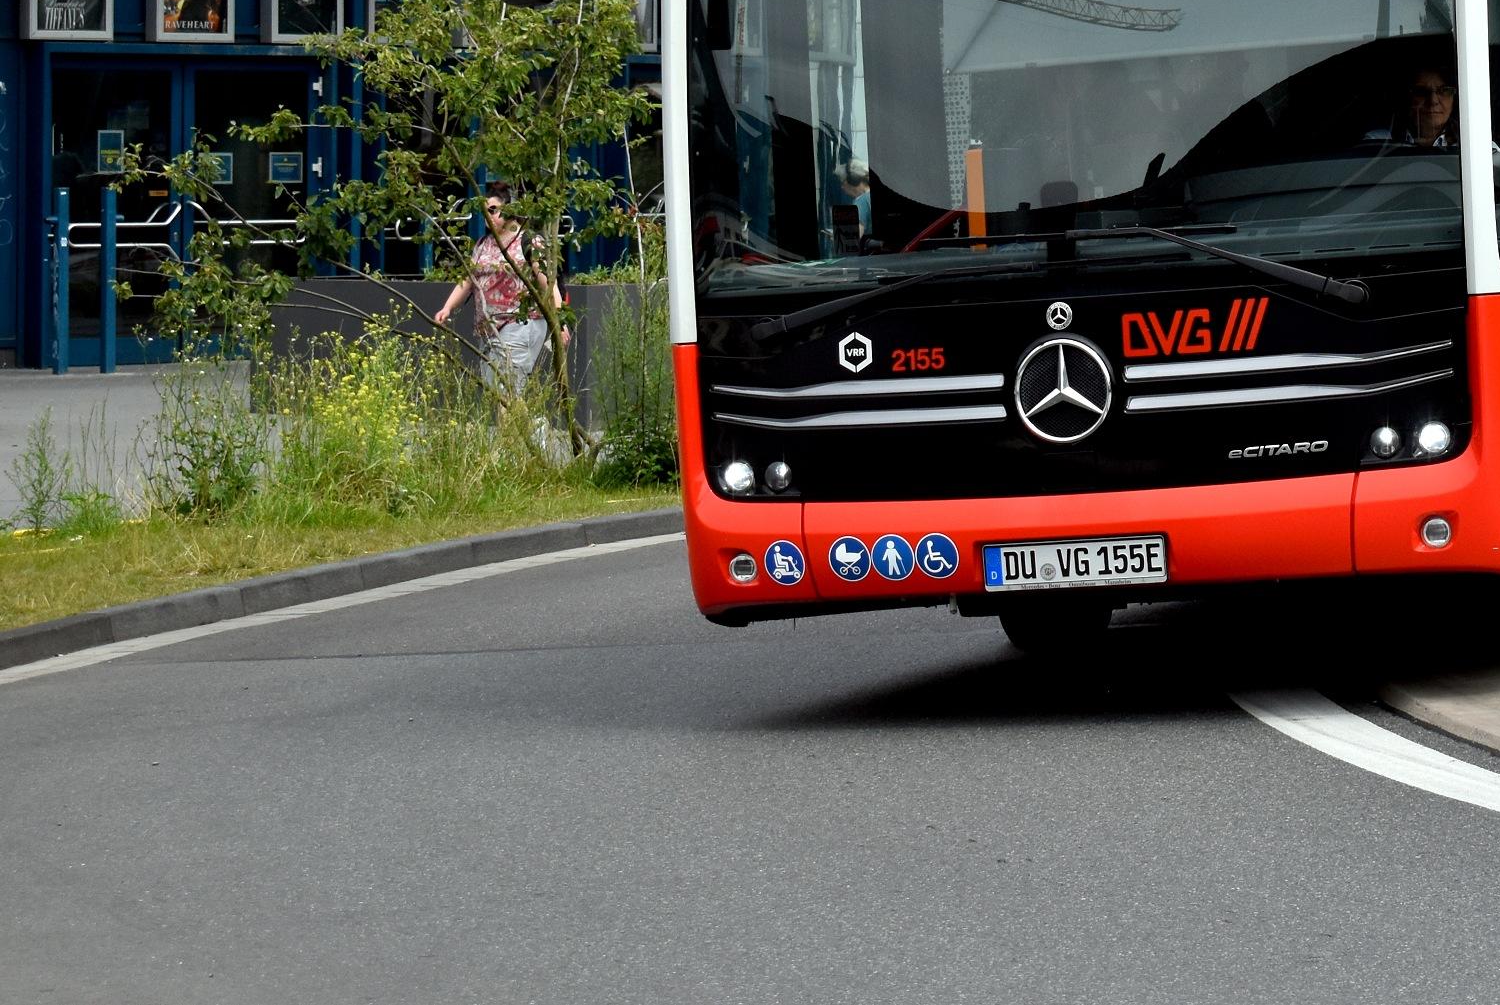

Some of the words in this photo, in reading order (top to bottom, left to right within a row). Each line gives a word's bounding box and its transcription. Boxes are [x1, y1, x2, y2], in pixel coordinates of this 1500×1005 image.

[165, 19, 216, 30] RAVEHEART
[1122, 308, 1212, 357] DVG
[846, 347, 865, 358] VRR
[891, 348, 945, 372] 2155
[1228, 440, 1329, 459] eCITARO
[1003, 550, 1037, 581] DU
[1056, 547, 1090, 577] VG
[1096, 543, 1163, 575] 155E
[991, 571, 998, 581] D
